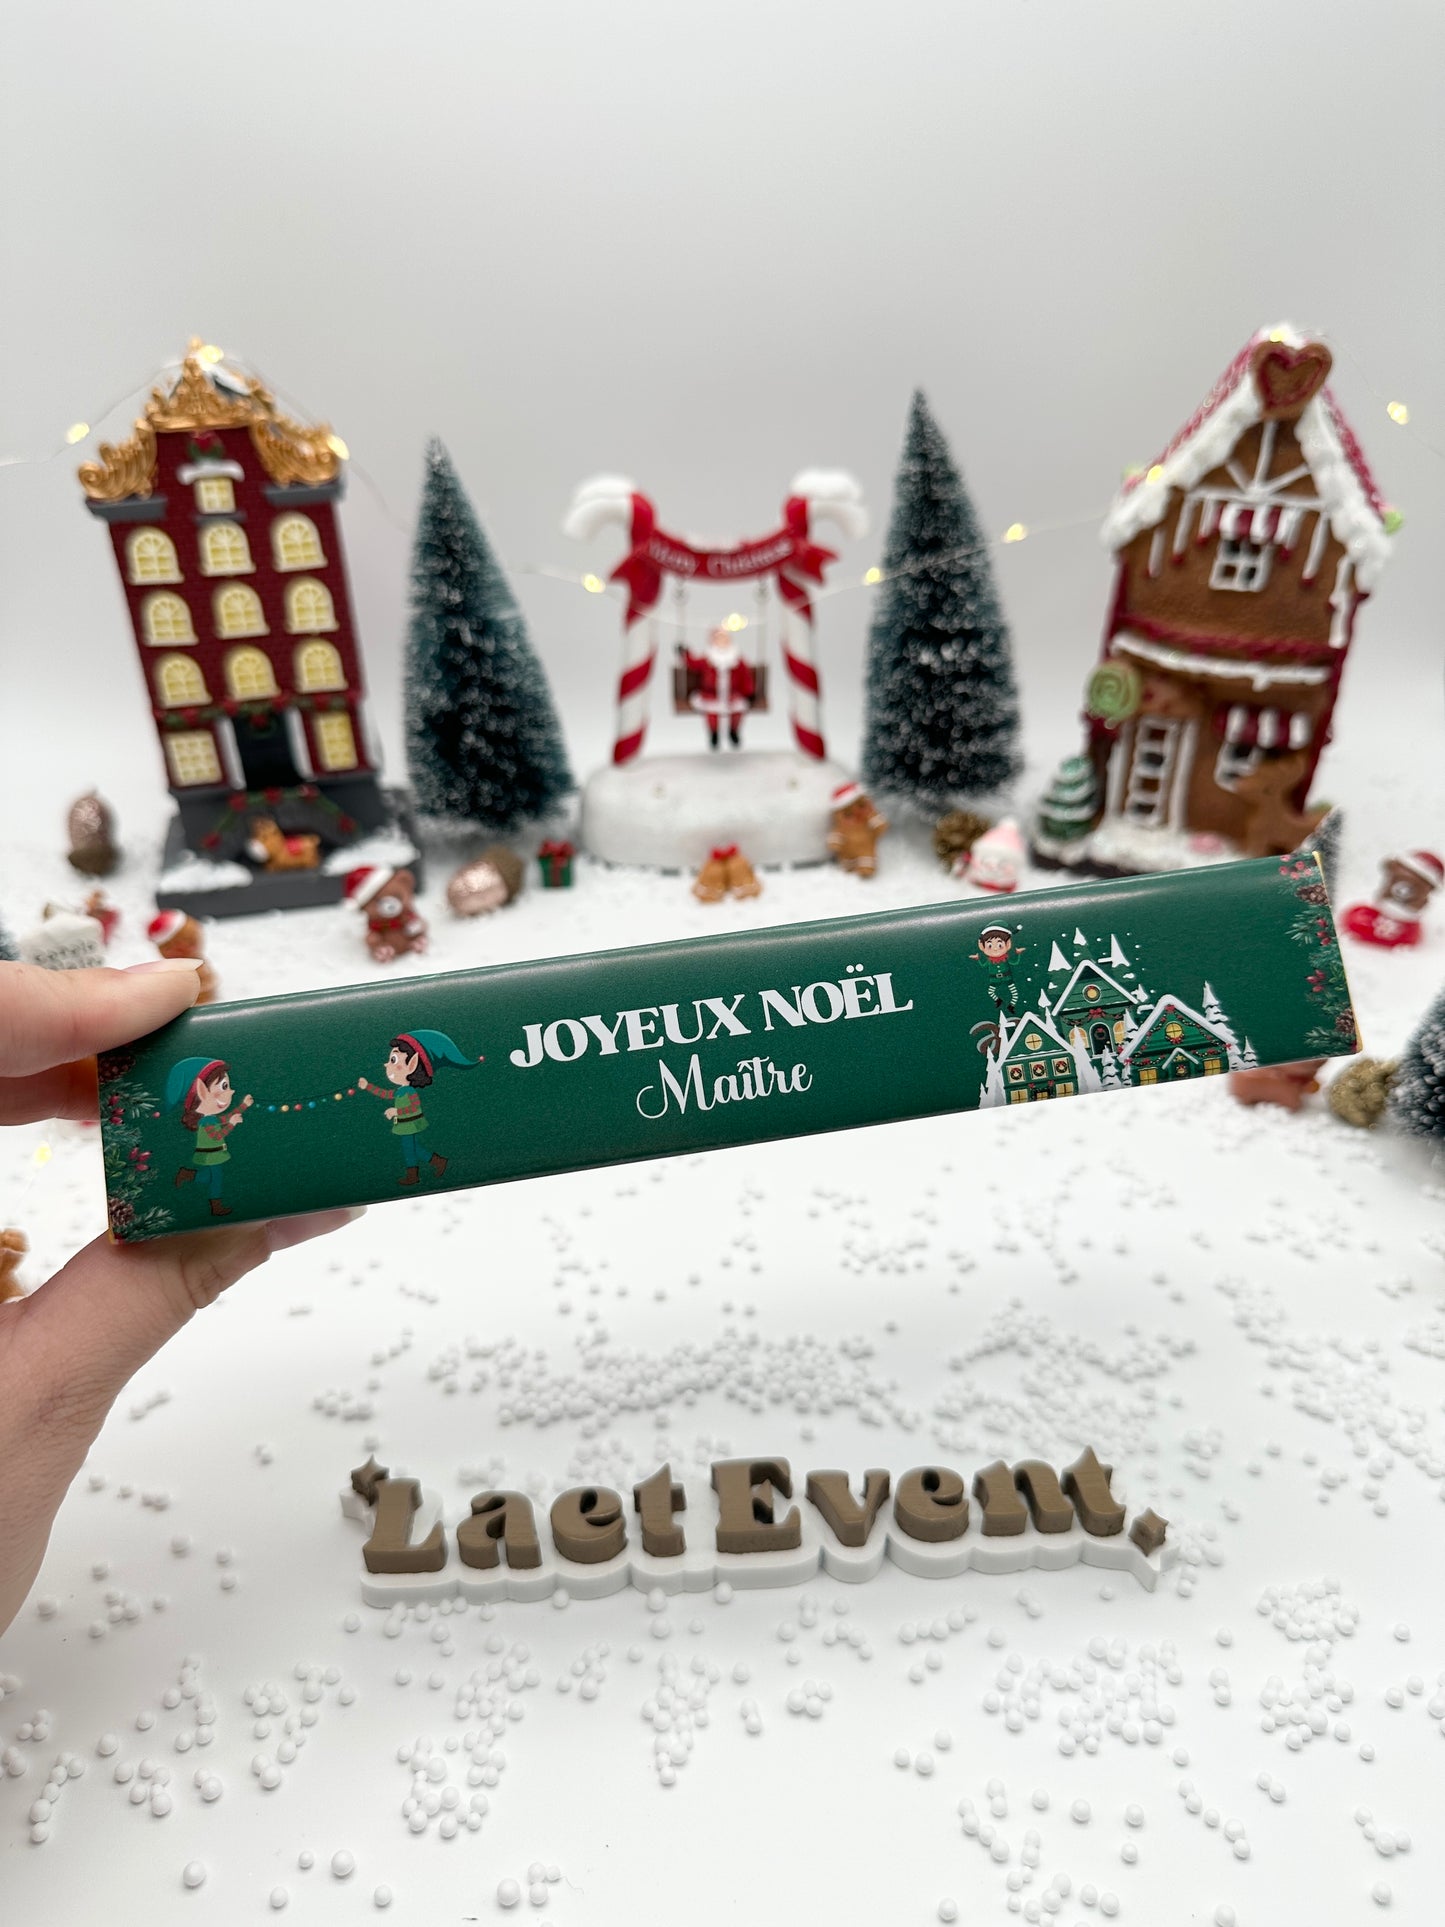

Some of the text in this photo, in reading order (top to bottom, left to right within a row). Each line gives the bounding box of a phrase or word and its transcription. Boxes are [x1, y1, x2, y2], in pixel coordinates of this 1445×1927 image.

[509, 963, 914, 1068] JOYEUX NOËL
[636, 1053, 813, 1120] Maître
[363, 1445, 1127, 1574] Laet Event
